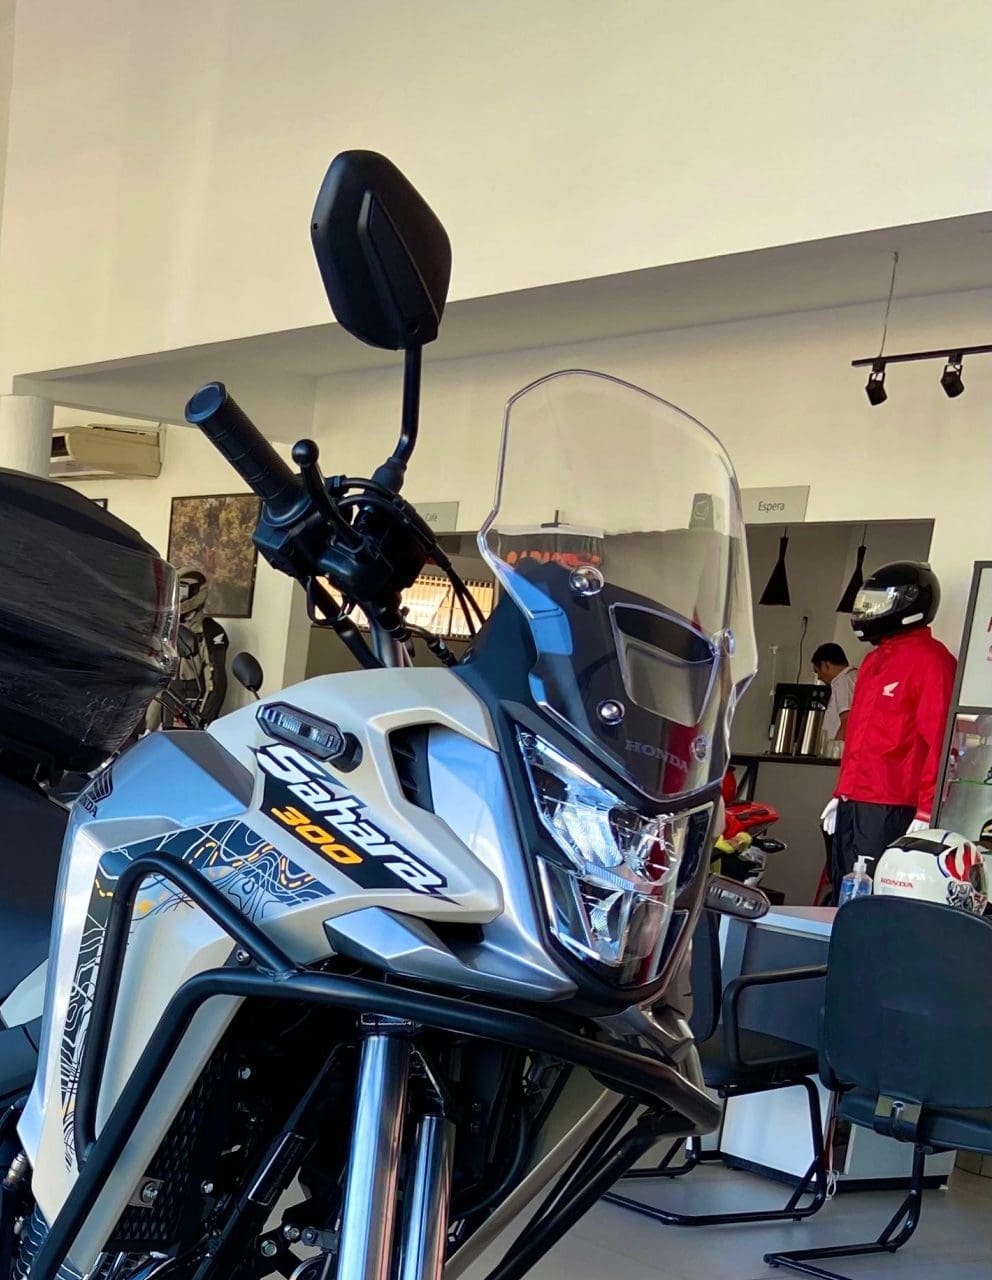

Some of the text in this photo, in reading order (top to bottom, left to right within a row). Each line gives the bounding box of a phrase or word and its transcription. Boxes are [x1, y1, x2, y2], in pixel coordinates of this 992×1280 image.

[758, 501, 785, 513] Espera
[624, 740, 688, 773] HONDA
[256, 744, 443, 894] Sahara
[271, 806, 363, 864] 300
[880, 877, 913, 888] HONDA
